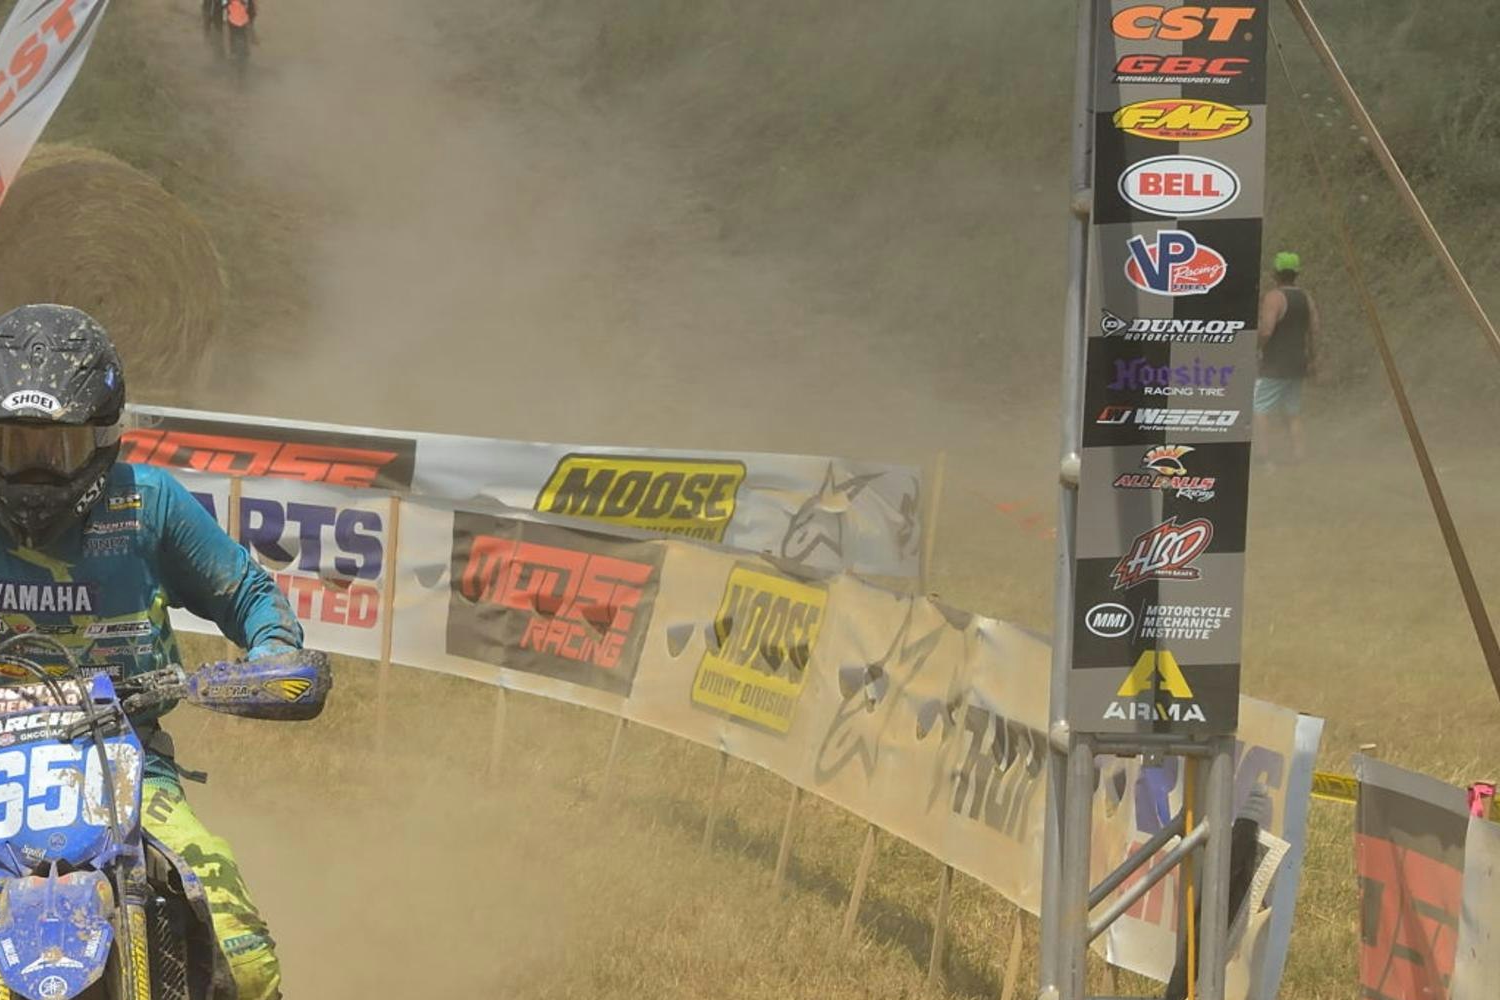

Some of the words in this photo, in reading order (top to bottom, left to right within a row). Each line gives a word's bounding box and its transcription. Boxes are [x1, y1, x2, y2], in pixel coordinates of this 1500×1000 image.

[1111, 6, 1256, 42] CST
[1116, 55, 1250, 76] GBC
[1115, 104, 1249, 131] FMF
[1139, 173, 1220, 197] BELL
[1127, 229, 1197, 293] VP
[1124, 332, 1198, 343] MOTORCYCLE
[1202, 333, 1235, 344] TIRES
[1128, 319, 1245, 334] DUNLOP
[11, 393, 53, 410] SHOEI
[1144, 387, 1194, 396] RACING
[1199, 387, 1226, 397] TIRE
[550, 467, 738, 519] MOOSE
[1126, 525, 1206, 575] HBD
[462, 534, 654, 635] MOOSE
[1093, 612, 1128, 628] MMI
[1146, 605, 1233, 618] MOTORCYCLE
[1143, 617, 1221, 629] MECHANICS
[519, 616, 628, 668] RACING
[1140, 628, 1211, 640] INSTITUTE
[1103, 702, 1206, 722] ARMA
